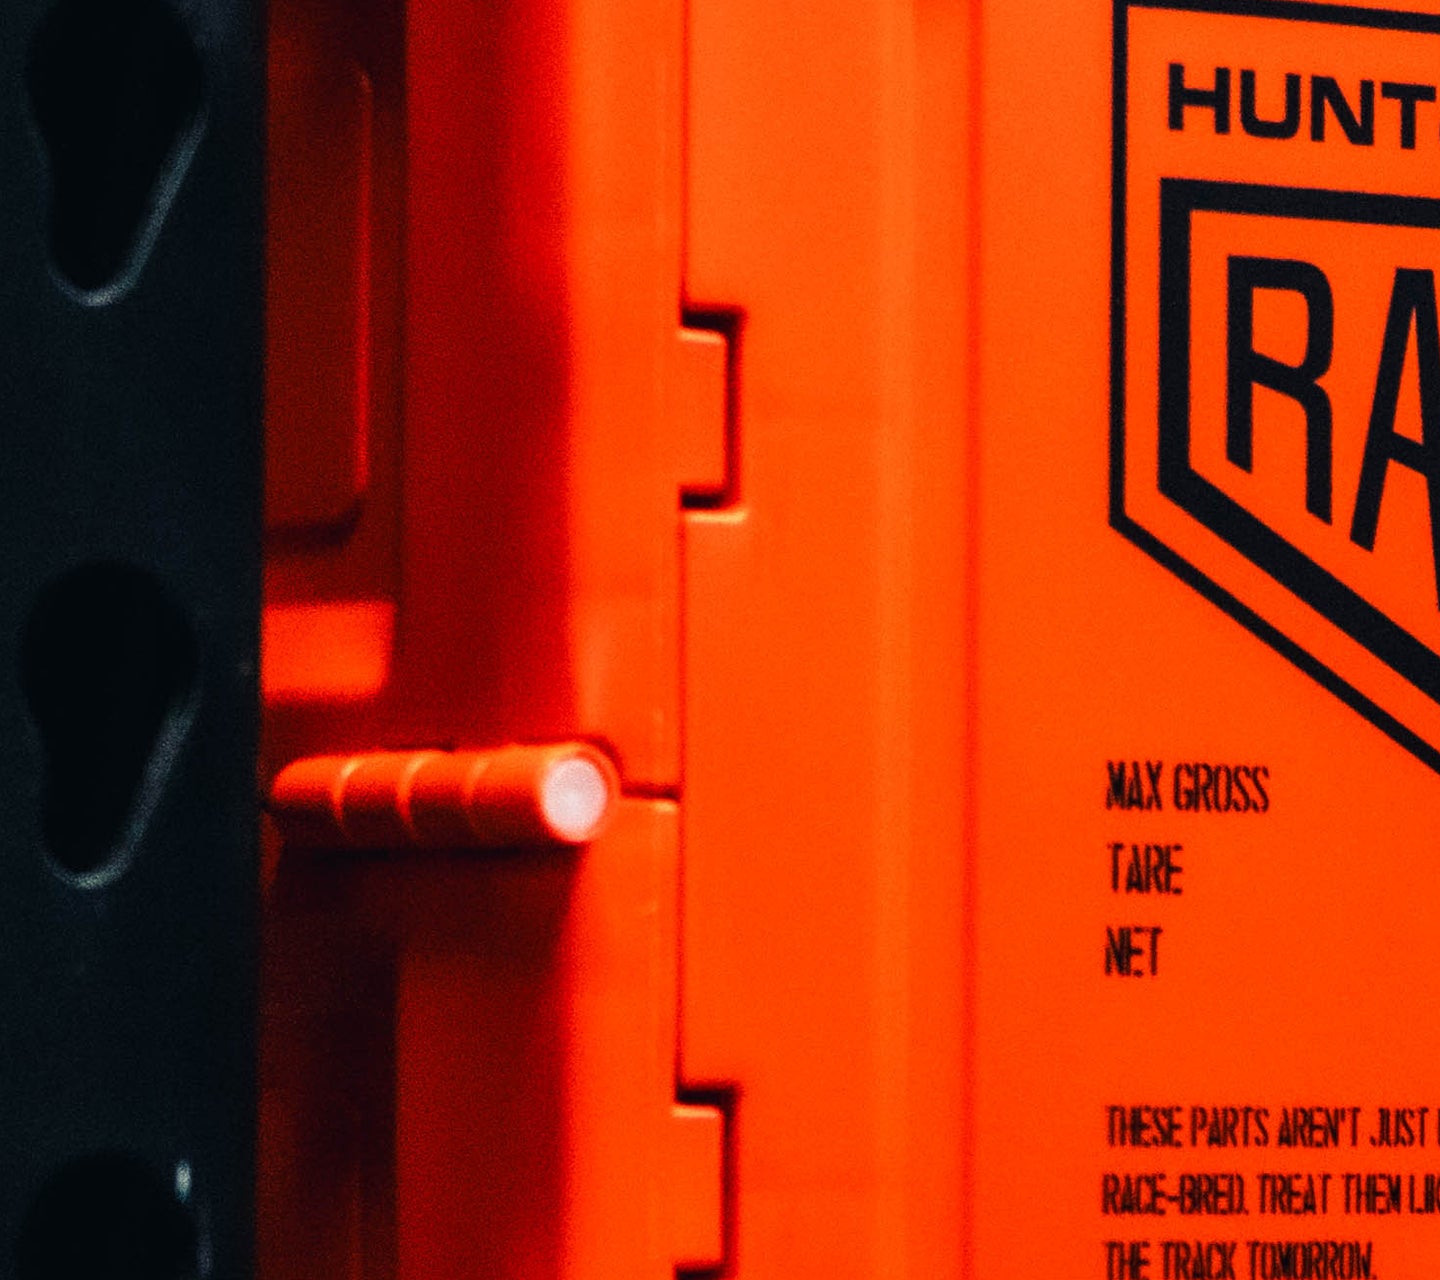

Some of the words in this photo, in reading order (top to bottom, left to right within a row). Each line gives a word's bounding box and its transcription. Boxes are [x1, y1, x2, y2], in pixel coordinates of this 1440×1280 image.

[1106, 760, 1163, 811] MAX
[1173, 763, 1269, 813] GROSS
[1107, 842, 1183, 894] TARE
[1105, 926, 1163, 977] NET
[1105, 1105, 1182, 1148] THESE
[1190, 1106, 1270, 1148] PARTS
[1278, 1107, 1361, 1148] AREN'T
[1370, 1108, 1429, 1148] JUST
[1256, 1173, 1332, 1215] TREAT
[1341, 1174, 1402, 1214] THEM
